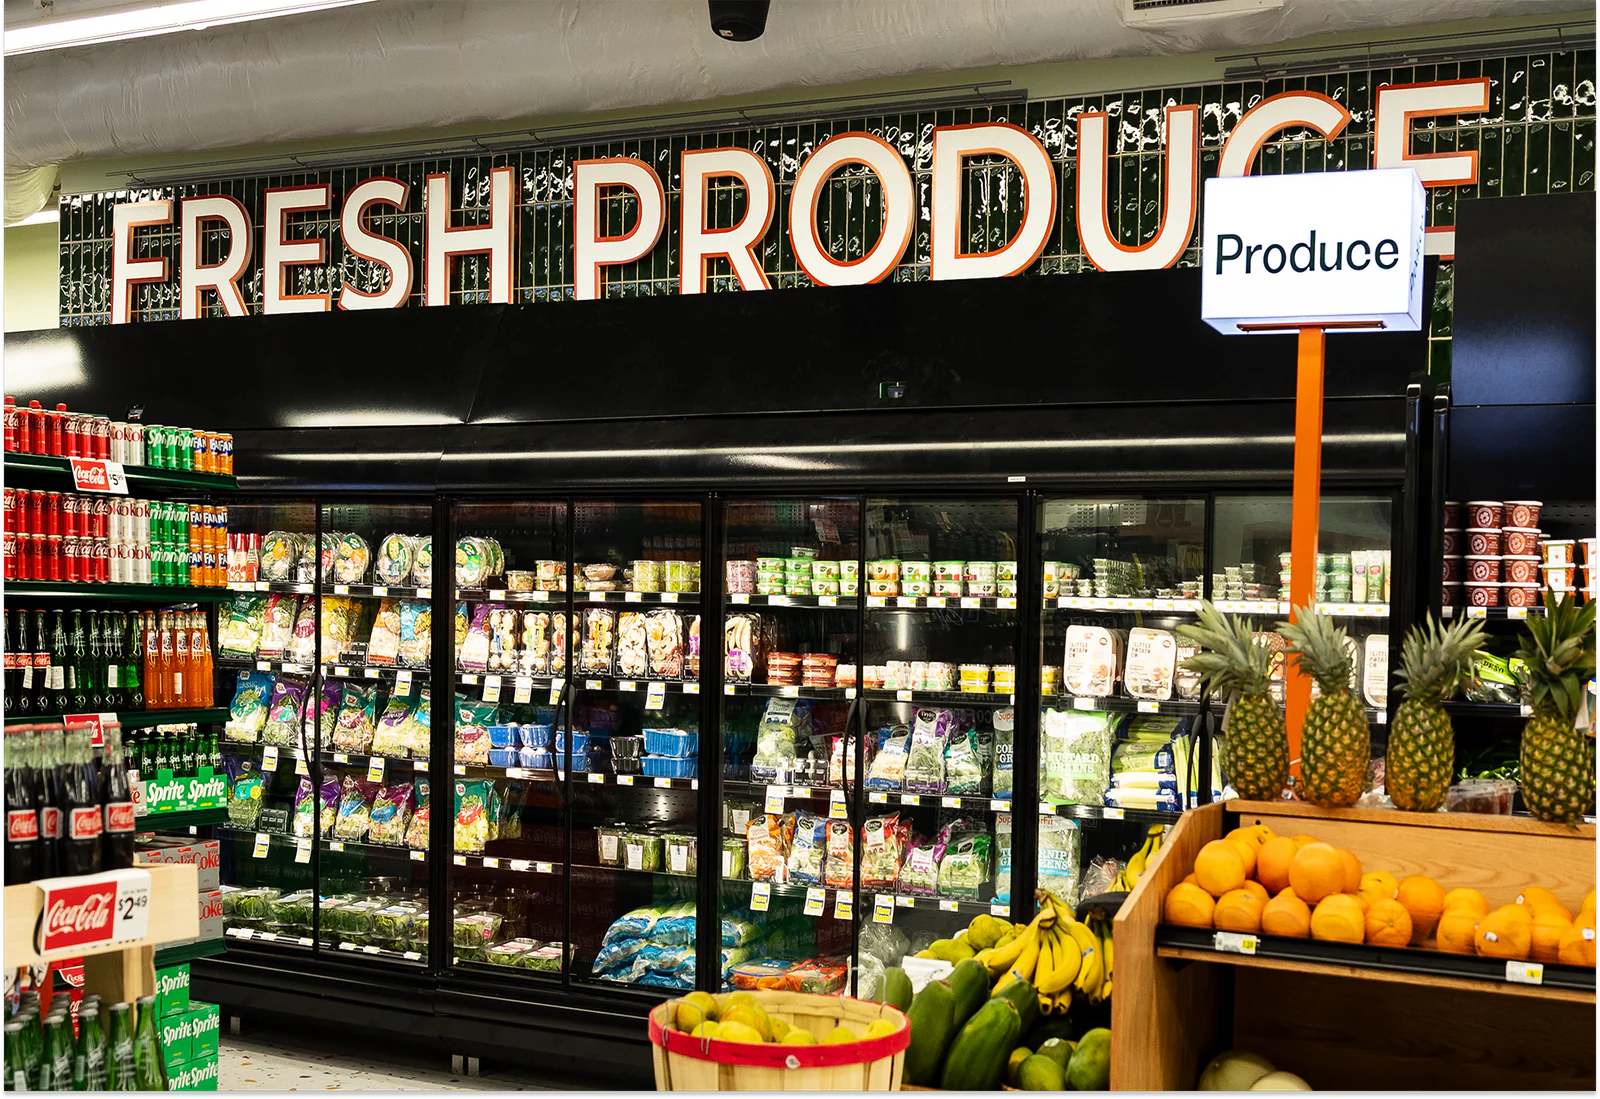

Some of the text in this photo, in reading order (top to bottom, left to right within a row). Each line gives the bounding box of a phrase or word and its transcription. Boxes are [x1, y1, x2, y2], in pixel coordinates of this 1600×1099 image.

[110, 166, 516, 325] FRESH
[1215, 229, 1399, 275] Produce
[147, 780, 185, 806] Sprite
[187, 777, 225, 802] Sprite
[161, 971, 190, 996] Sprite
[163, 1021, 192, 1046] Sprite
[192, 1013, 220, 1038] Sprite
[169, 1071, 191, 1091] prite
[190, 1061, 218, 1087] Sprite
